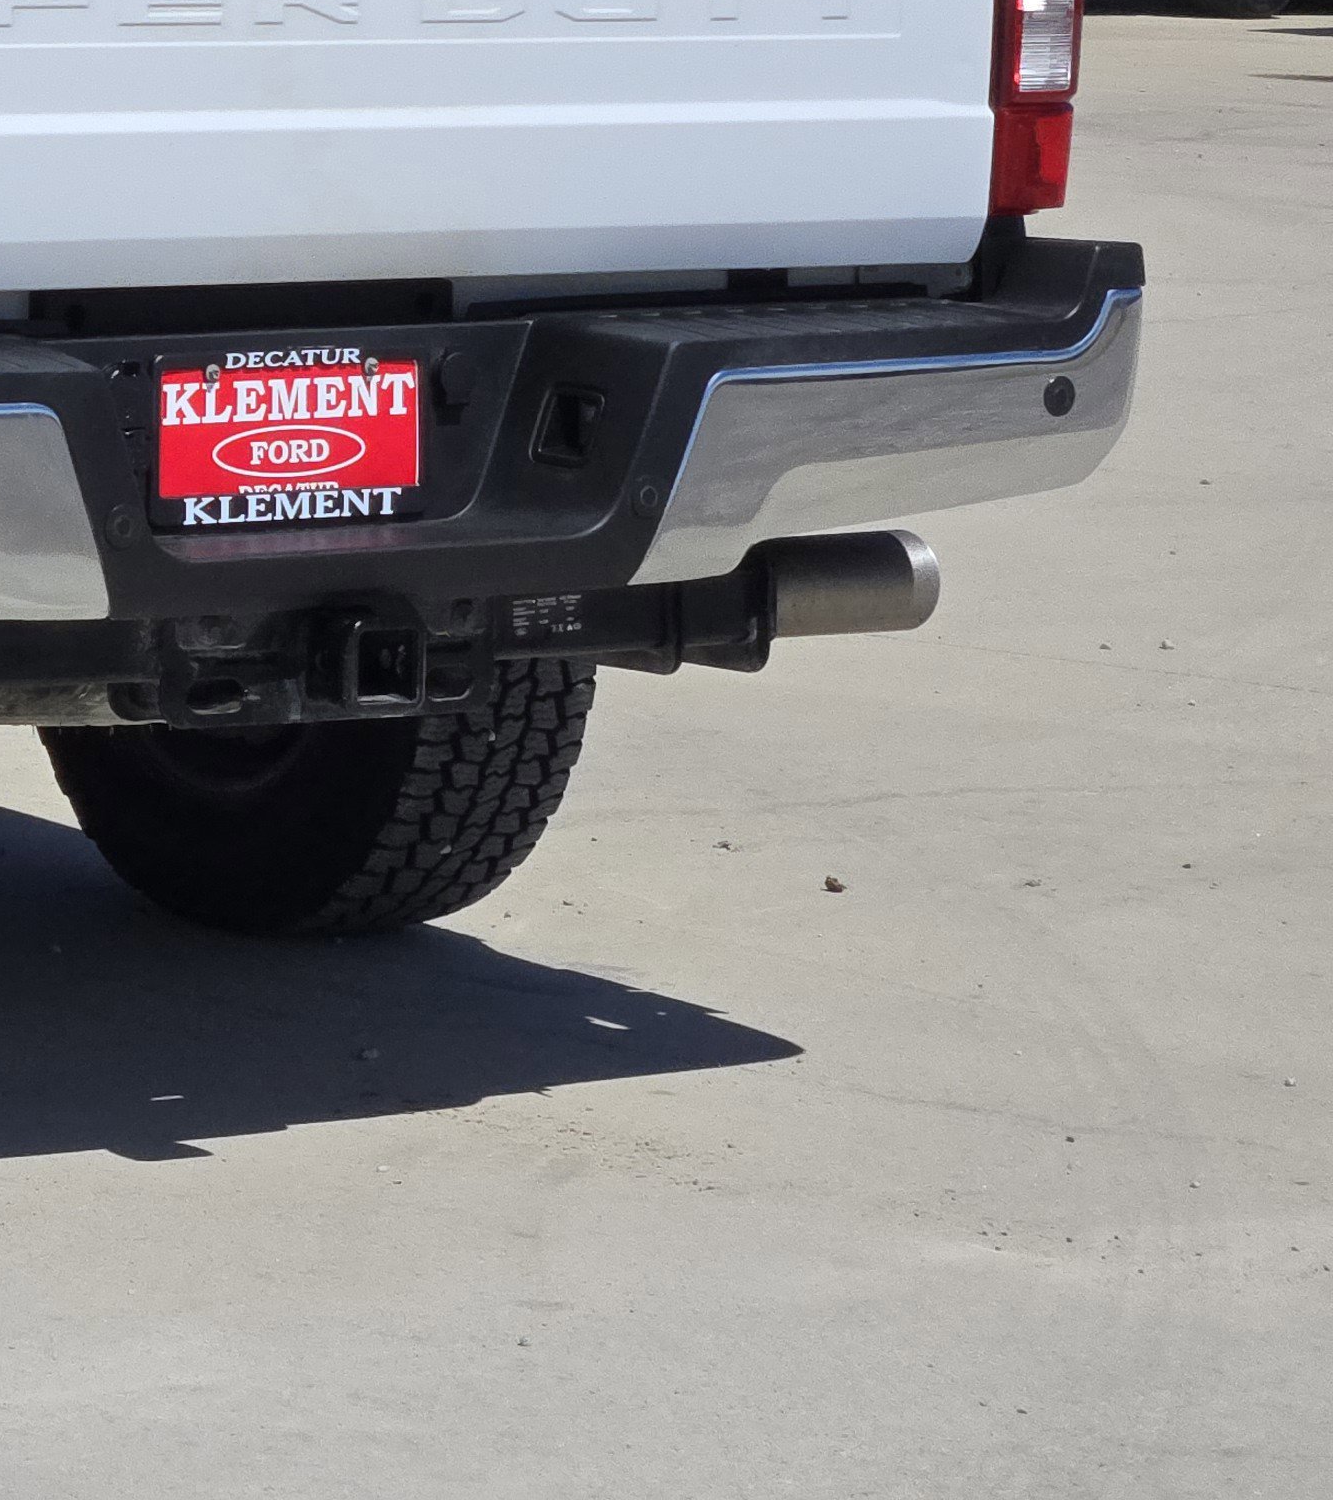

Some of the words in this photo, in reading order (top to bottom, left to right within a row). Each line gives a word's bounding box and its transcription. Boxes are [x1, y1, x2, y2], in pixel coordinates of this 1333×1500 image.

[224, 348, 361, 369] DECATUR
[162, 372, 415, 426] KLEMENT
[250, 438, 330, 465] FORD
[183, 487, 402, 526] KLEMENT
